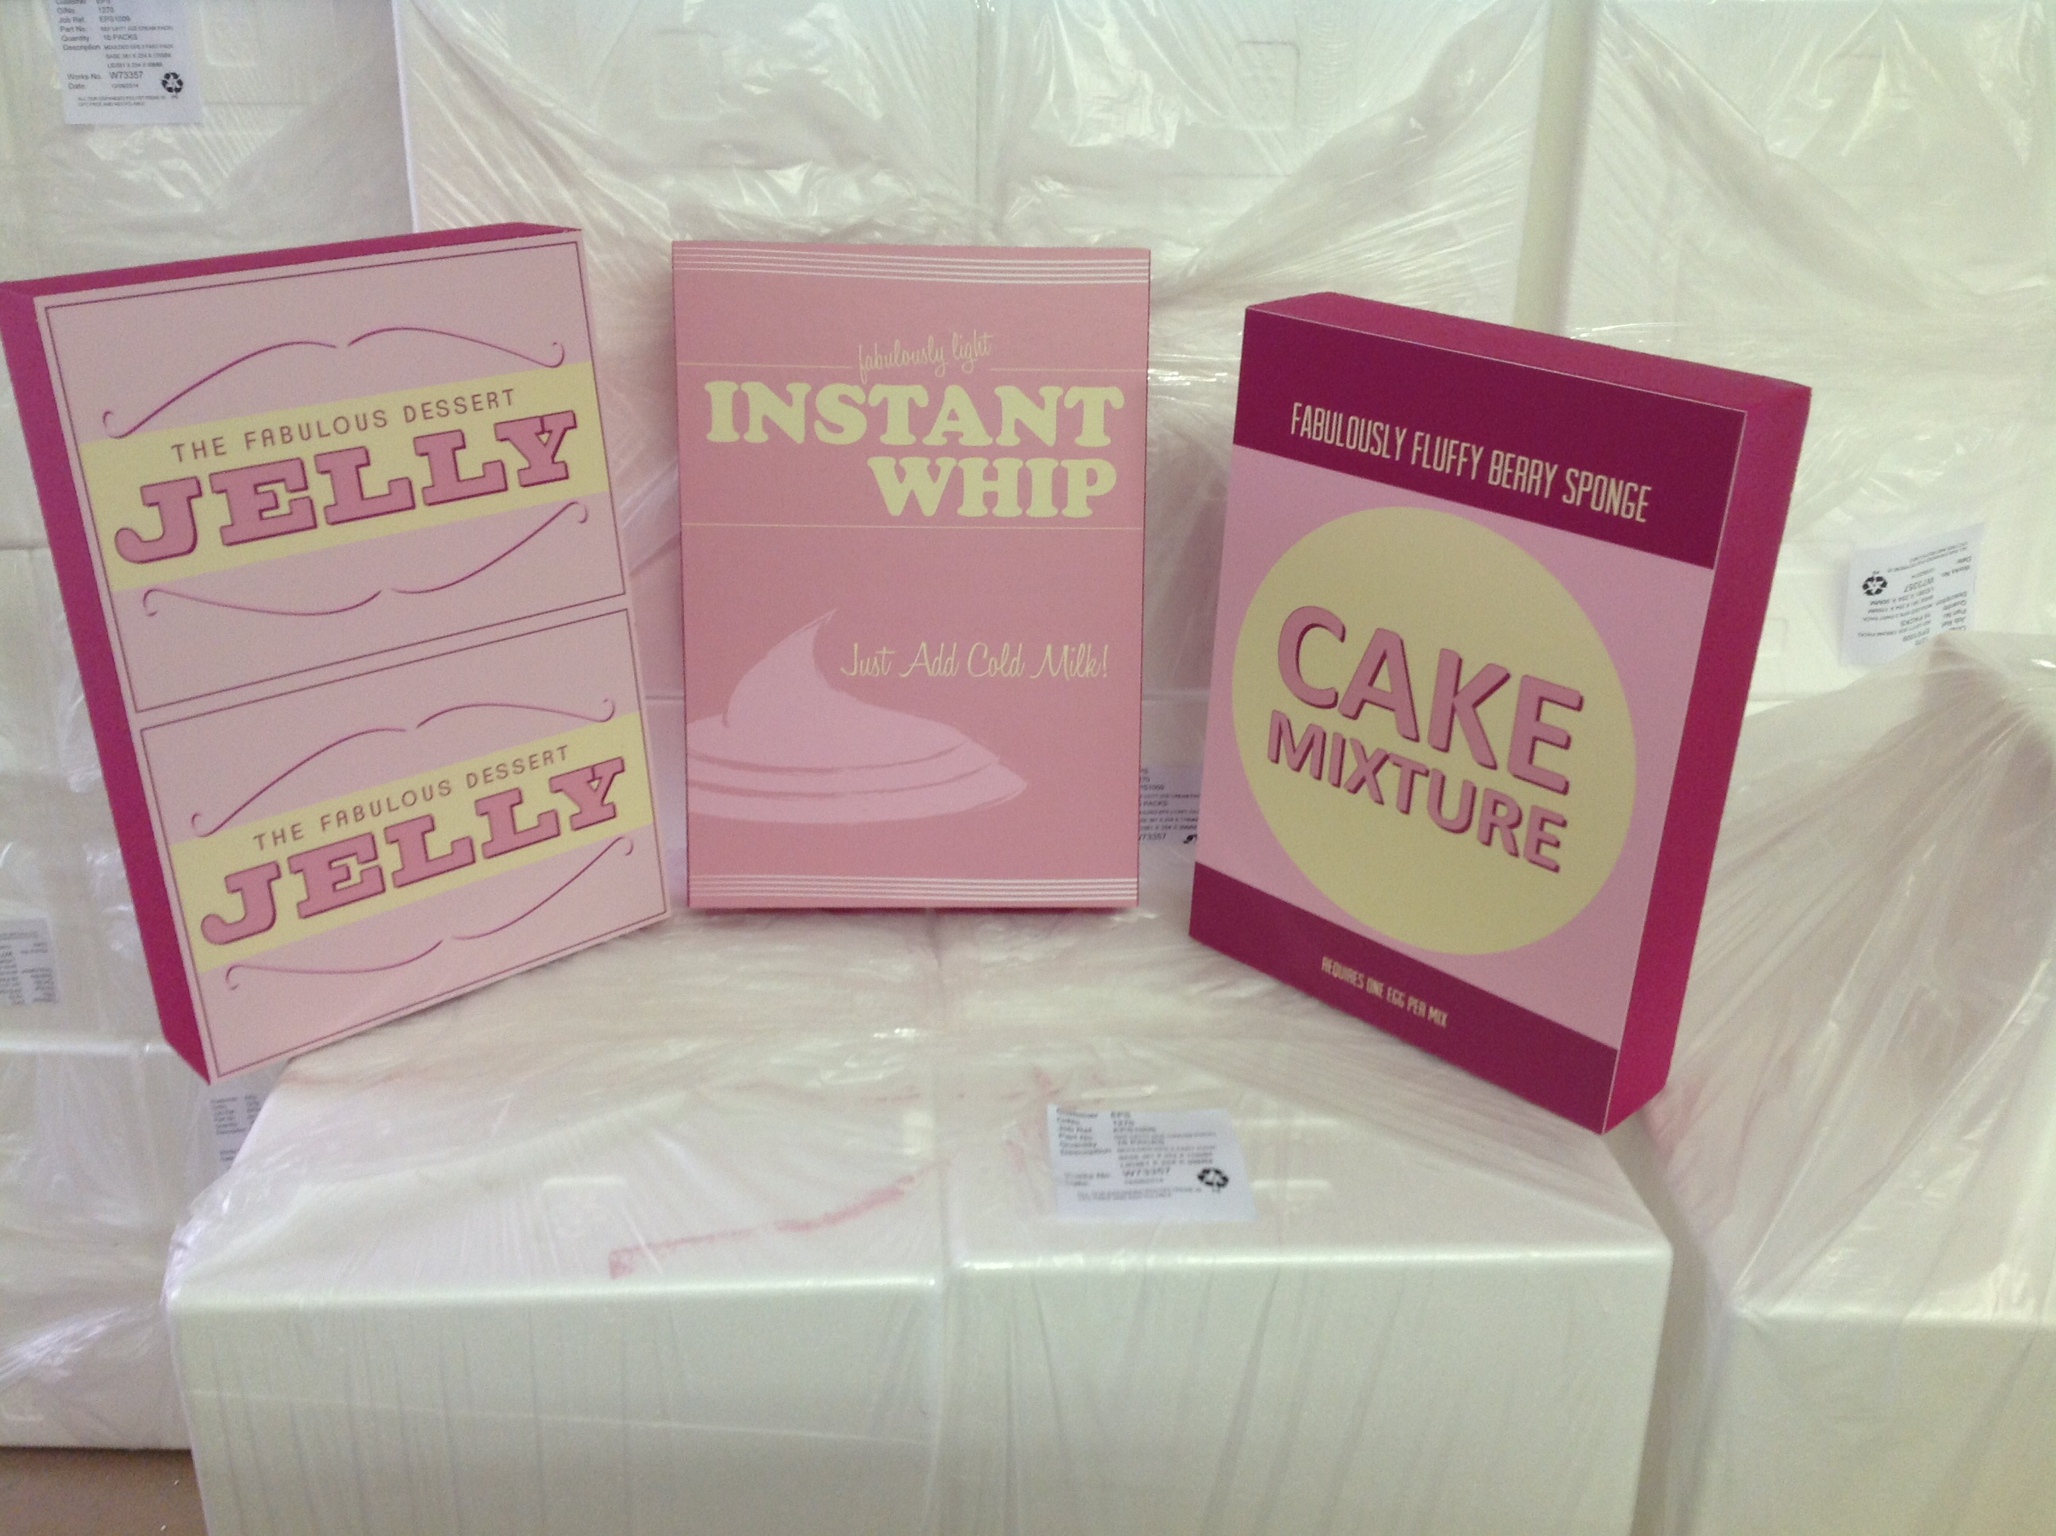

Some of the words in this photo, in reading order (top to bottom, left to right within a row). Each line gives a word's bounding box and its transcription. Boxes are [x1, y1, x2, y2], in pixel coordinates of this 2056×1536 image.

[109, 70, 144, 79] W73357
[859, 334, 945, 384] fabulously
[952, 329, 994, 374] light
[171, 436, 227, 464] THE
[244, 409, 389, 451] FABULOUS
[403, 388, 516, 424] DESSERT
[704, 380, 1126, 447] INSTANT
[114, 409, 578, 565] JELLY
[867, 456, 1118, 519] WHIP
[1290, 402, 1409, 462] FABULOUSLY
[1410, 431, 1487, 482] FLUFFY
[1487, 449, 1560, 500] BERRY
[1561, 467, 1653, 524] SPONGE
[840, 642, 896, 677] Just
[899, 641, 959, 678] Add
[967, 641, 1026, 678] Cold
[1029, 642, 1110, 681] Milk!
[1277, 604, 1585, 796] CAKE
[253, 822, 305, 852] THE
[319, 779, 453, 834] FABULOUS
[466, 745, 570, 790] DESSERT
[1267, 708, 1568, 874] MIXTURE
[200, 756, 626, 946] JELLY
[1321, 955, 1365, 990] REQUIRES
[1366, 976, 1385, 998] ONE
[1386, 985, 1406, 1009] EGG
[1407, 995, 1427, 1019] PER
[1427, 1006, 1449, 1029] MIX
